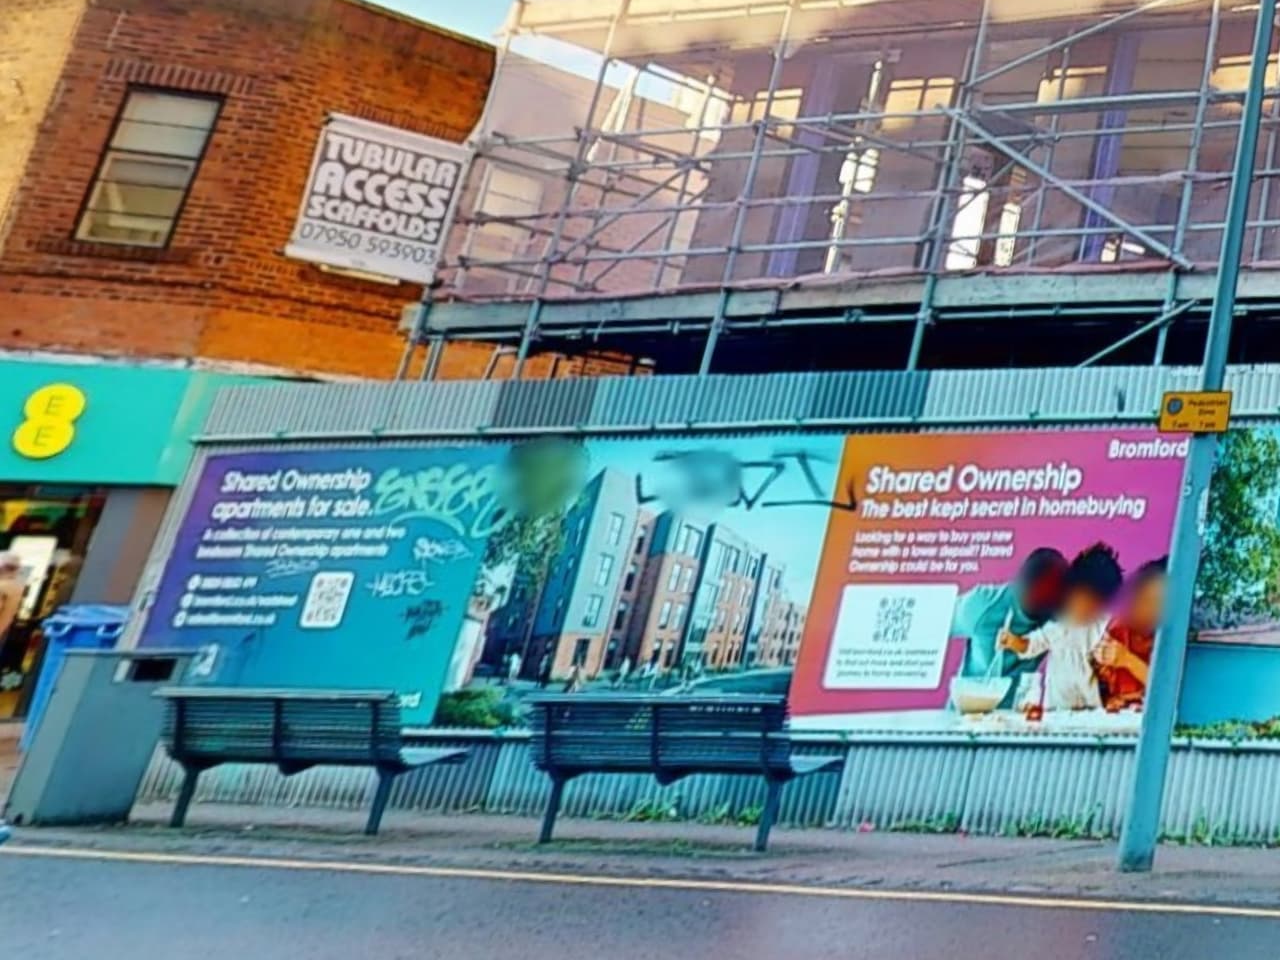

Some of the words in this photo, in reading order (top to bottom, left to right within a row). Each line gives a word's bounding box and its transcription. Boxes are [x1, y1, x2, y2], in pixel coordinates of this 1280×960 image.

[326, 134, 457, 188] TUBULAR
[314, 161, 451, 220] ACCESS
[307, 195, 441, 242] SCAFFOLDS
[300, 222, 362, 248] 07950
[366, 236, 436, 265] 593903
[1109, 438, 1189, 458] Bromford
[222, 470, 280, 492] Shared
[282, 468, 371, 493] Ownership
[867, 466, 953, 494] Shared
[958, 464, 1083, 495] Ownership
[212, 497, 304, 523] apartments
[307, 495, 331, 517] for
[333, 495, 373, 517] sale.
[862, 501, 890, 519] The
[892, 499, 927, 518] best
[931, 498, 968, 521] kept
[971, 498, 1019, 517] secret
[1020, 496, 1038, 515] in
[1039, 494, 1146, 520] homebuying
